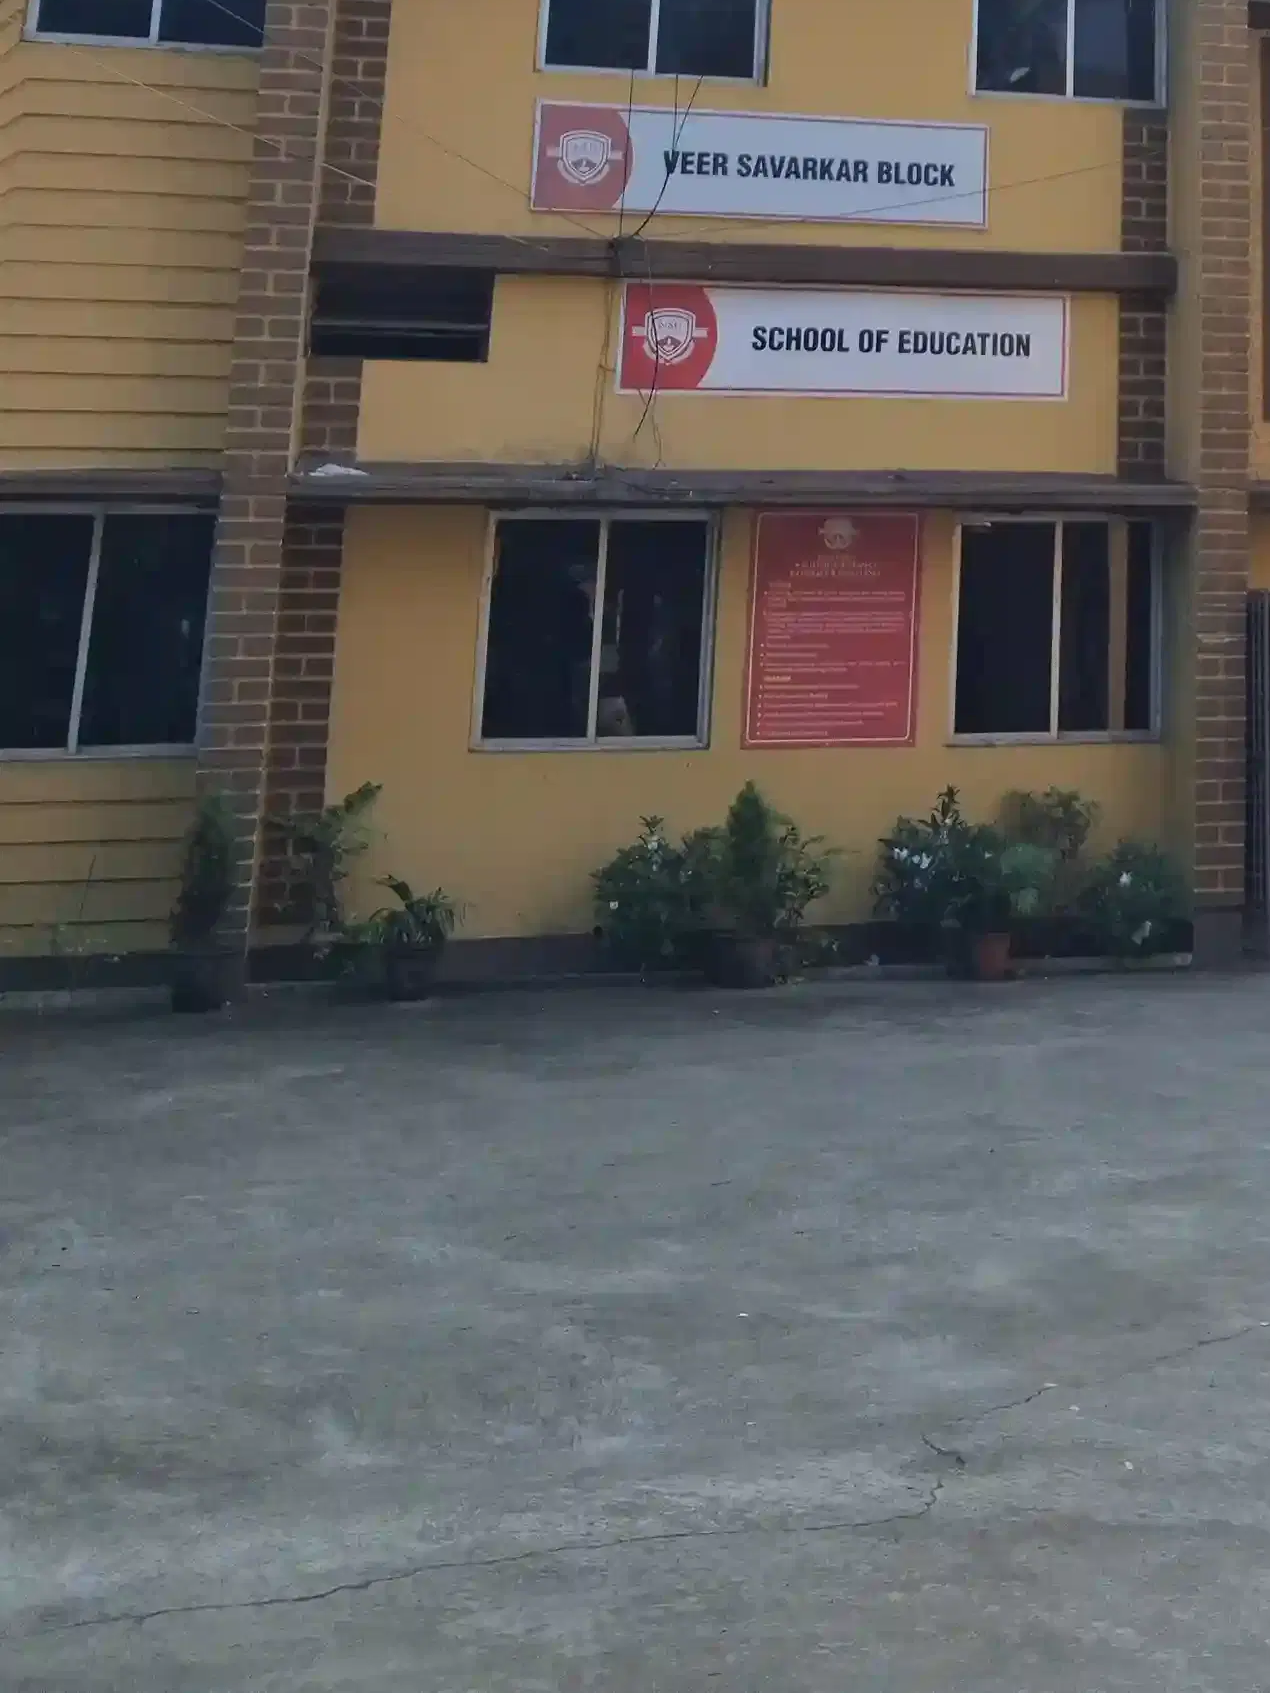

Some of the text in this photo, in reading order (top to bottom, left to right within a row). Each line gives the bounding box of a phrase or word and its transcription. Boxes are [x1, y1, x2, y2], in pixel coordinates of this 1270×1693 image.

[662, 150, 955, 187] VEER SAVARKAR BLOCK
[751, 326, 1031, 358] SCHOOL OF EDUCATION
